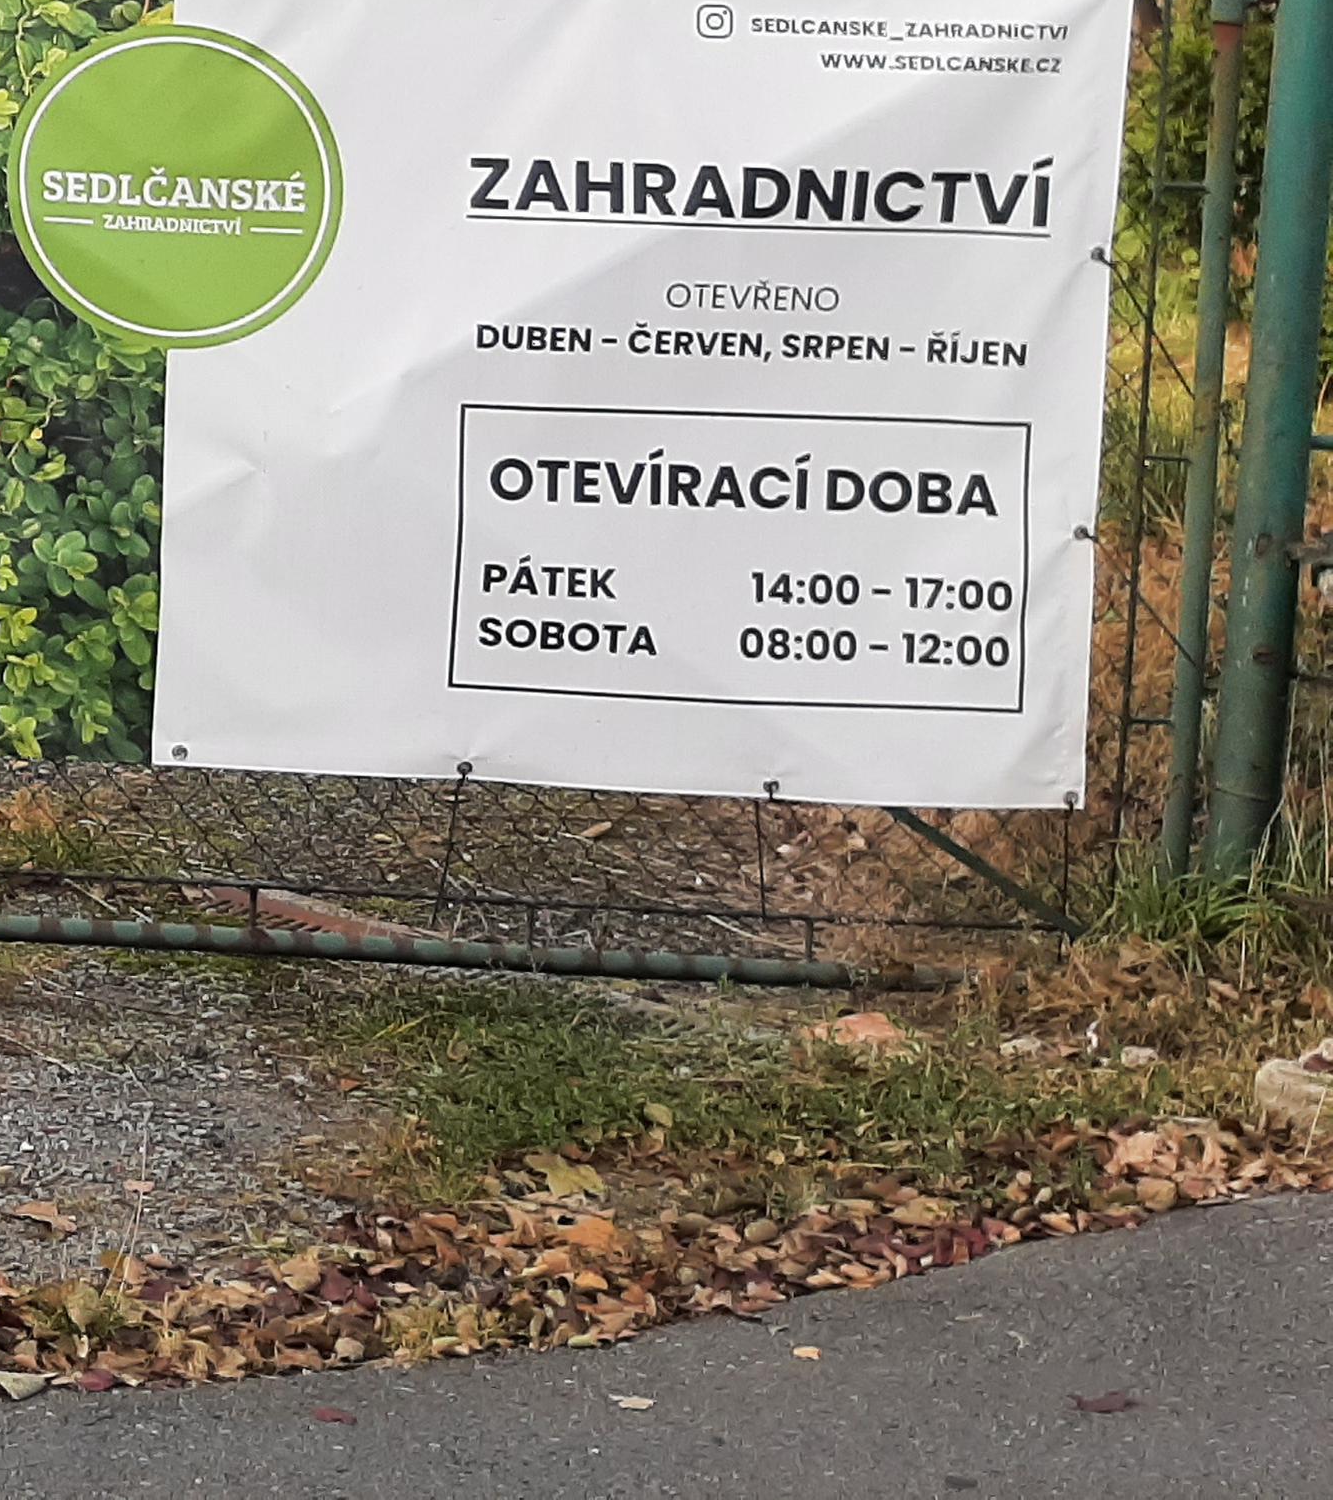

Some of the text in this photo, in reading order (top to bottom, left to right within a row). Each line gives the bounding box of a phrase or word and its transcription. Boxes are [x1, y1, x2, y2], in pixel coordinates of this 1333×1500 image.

[821, 52, 1063, 74] WWW.SEDLCANSKE.CZ
[41, 166, 306, 213] SEDLČANSKÉ
[469, 156, 1054, 227] ZAHRADNICTVÍ
[103, 214, 242, 235] ZAHRADNICTVÍ
[665, 280, 840, 313] OTEVŘENO
[475, 323, 591, 354] DUBEN
[628, 323, 772, 362] ČERVEN,
[781, 333, 890, 362] SRPEN
[925, 330, 1028, 367] ŘÍJEN
[489, 448, 998, 517] OTEVÍRACÍ DOBA
[482, 555, 617, 600] PÁTEK
[751, 572, 860, 606] 14:00
[904, 577, 1013, 612] 17:00
[478, 617, 658, 656] SOBOTA
[739, 627, 857, 662] 08:00
[902, 632, 1011, 667] 12:00
